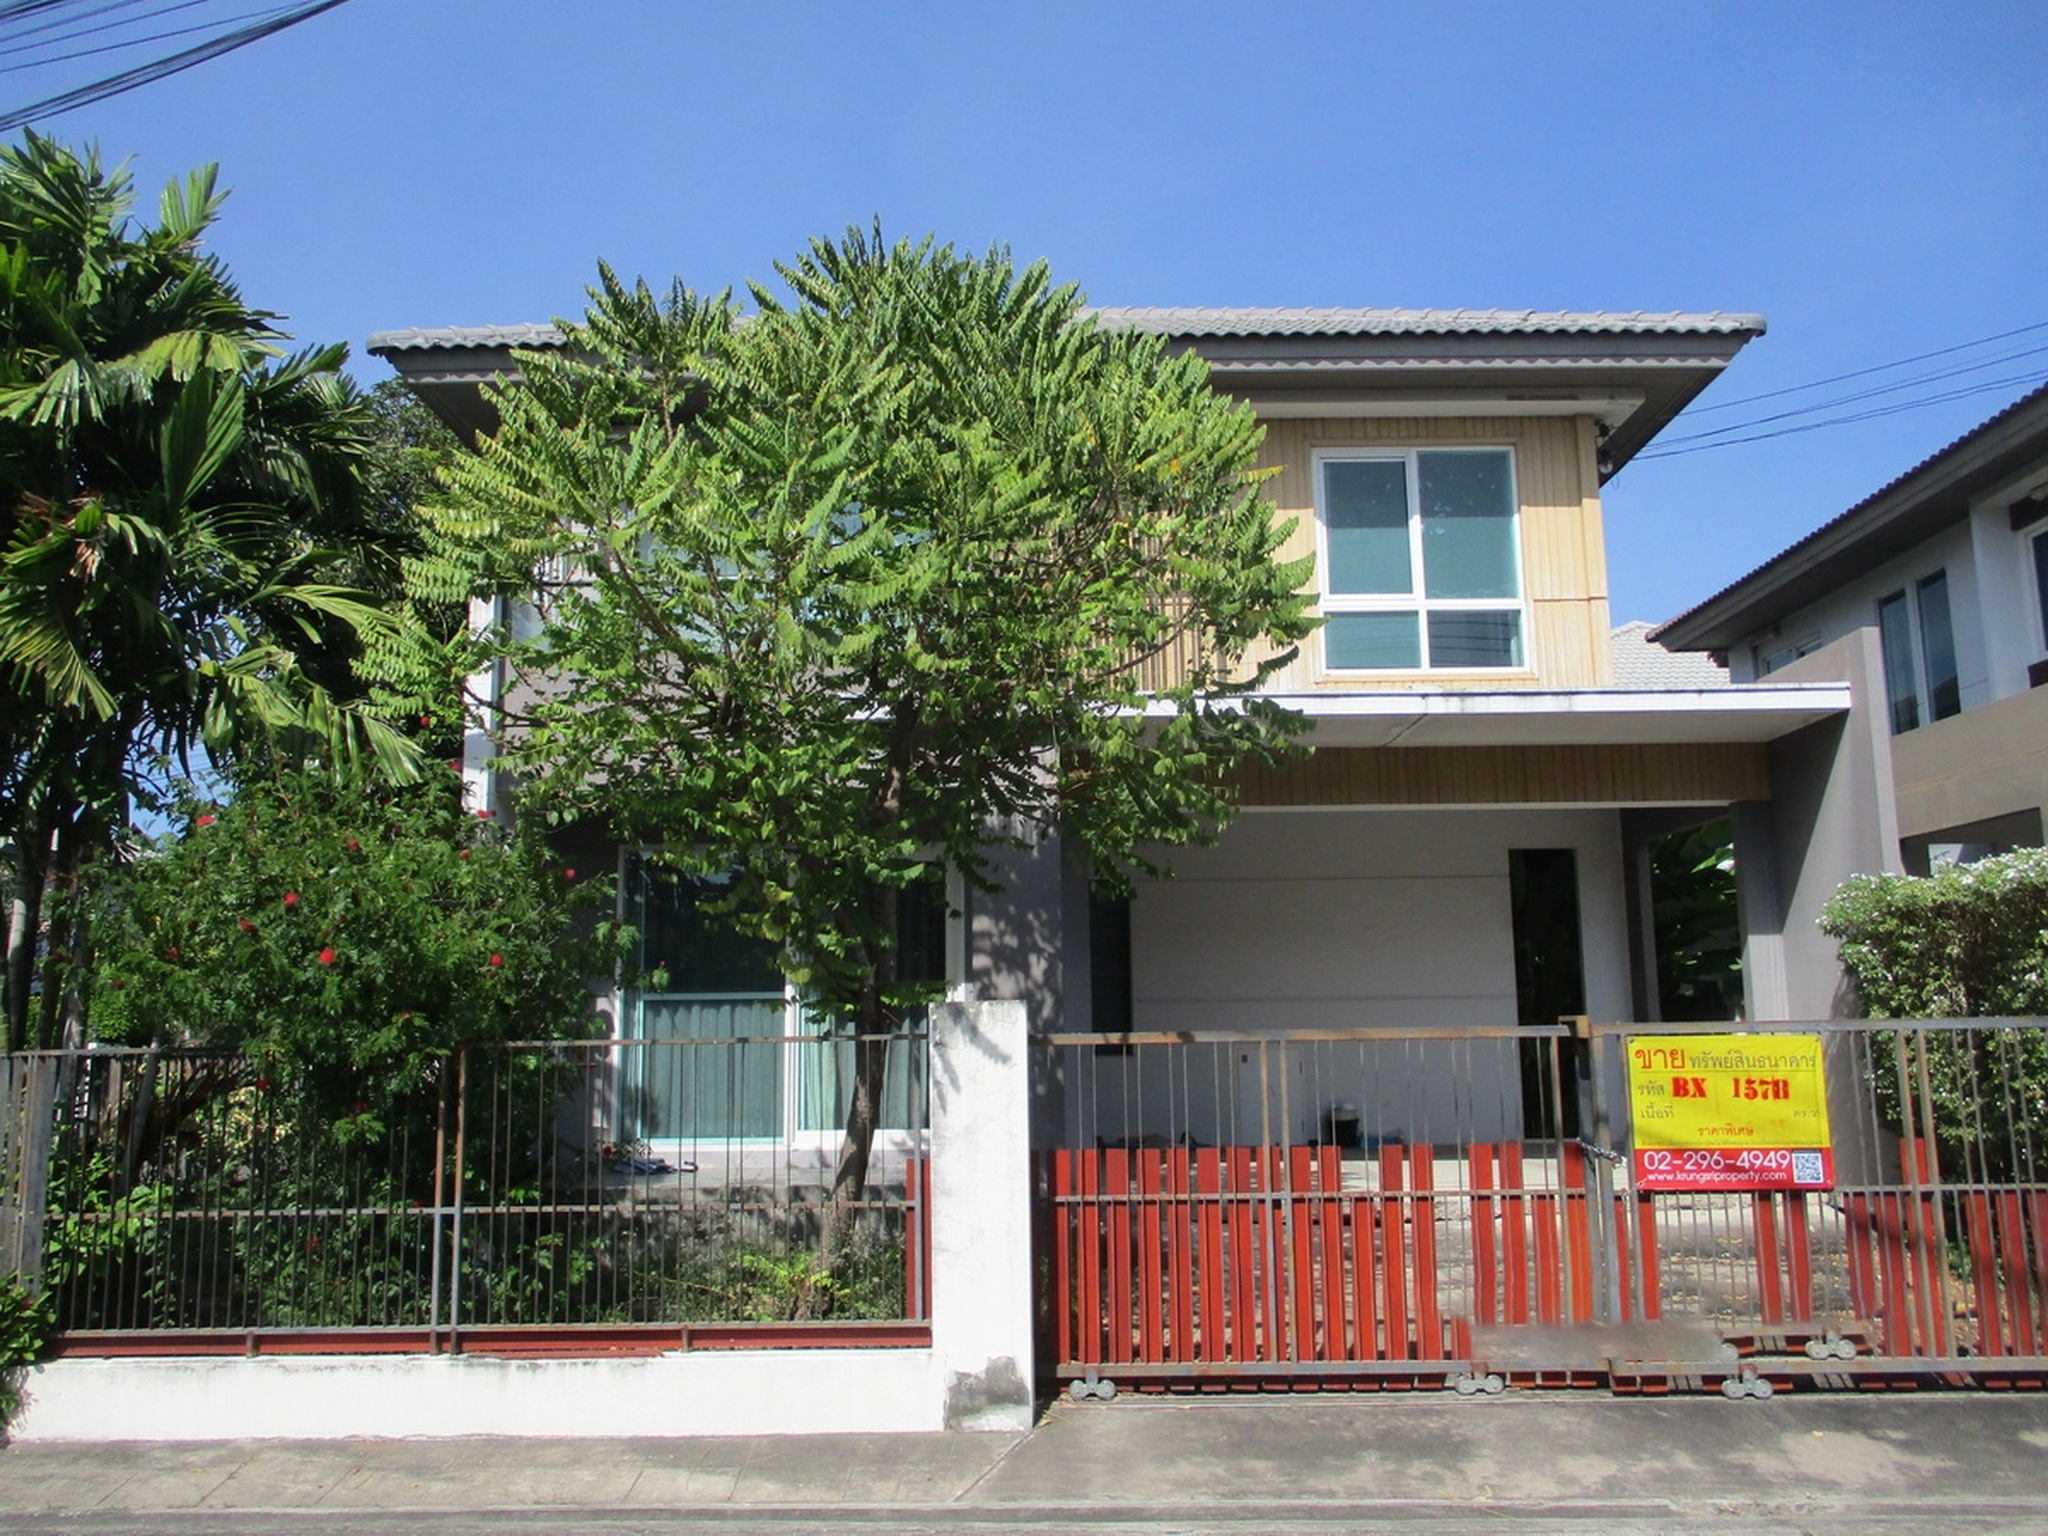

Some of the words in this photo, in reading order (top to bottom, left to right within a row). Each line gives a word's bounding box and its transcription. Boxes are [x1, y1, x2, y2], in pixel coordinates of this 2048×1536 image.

[1634, 1048, 1686, 1069] ขาย
[1690, 1049, 1816, 1068] ทรัพย์สินธนาคาร
[1637, 1079, 1665, 1096] รหัส
[1672, 1076, 1707, 1098] BX
[1697, 1122, 1754, 1136] ราคาพิเศษ
[1644, 1150, 1790, 1170] 02-296-4949
[1647, 1171, 1787, 1183] www.krungsriproperty.com
